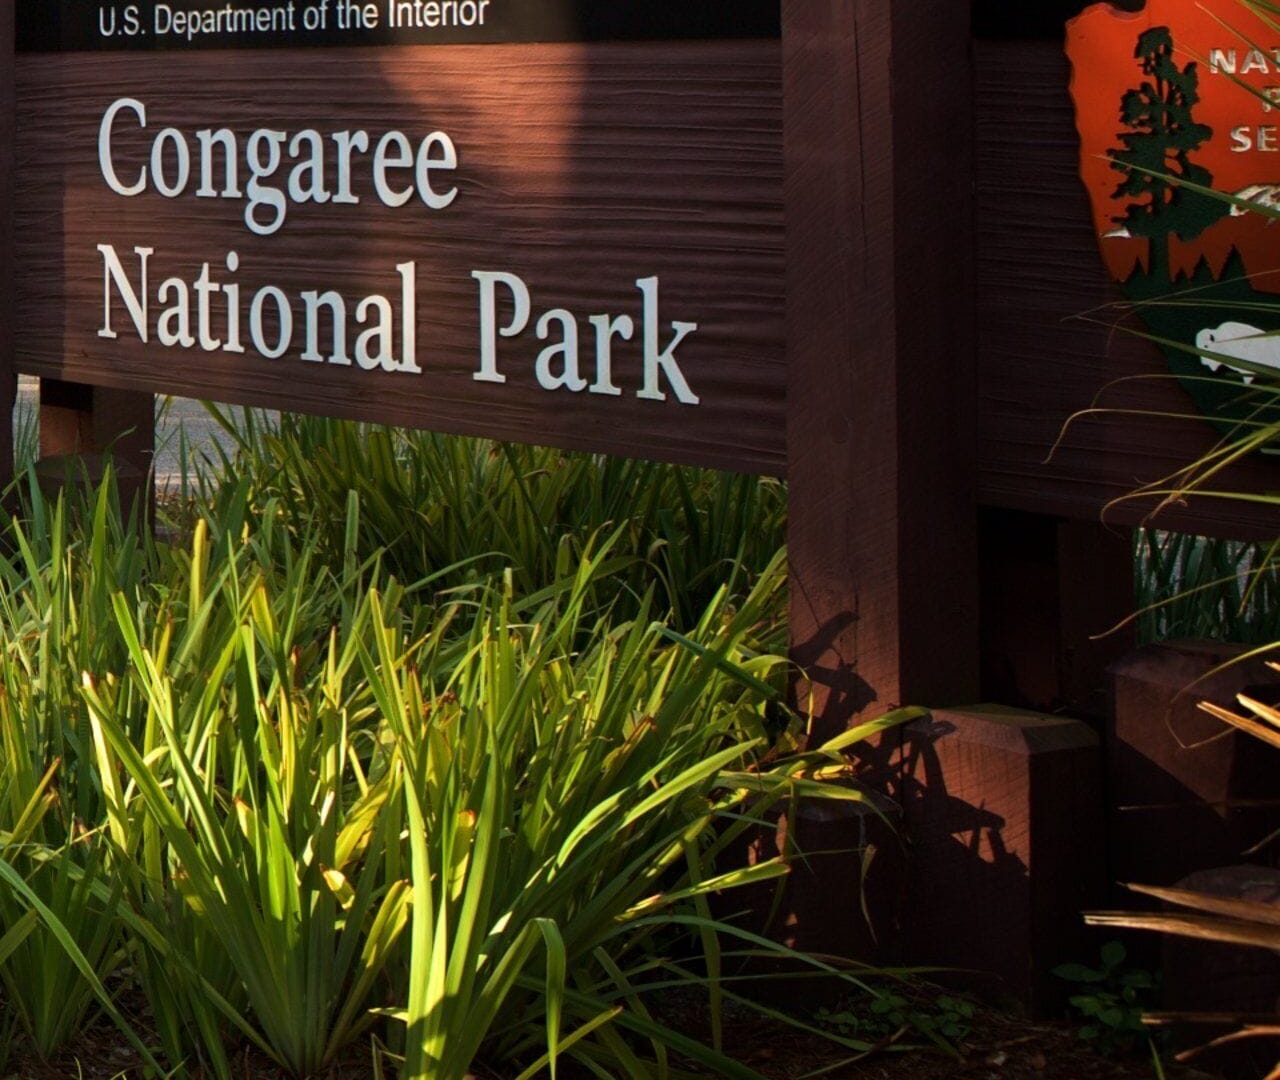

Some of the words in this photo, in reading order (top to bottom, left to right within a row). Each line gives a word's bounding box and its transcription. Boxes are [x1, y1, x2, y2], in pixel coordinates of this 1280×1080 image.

[99, 6, 146, 37] U.S.
[154, 1, 296, 41] Department
[98, 97, 458, 235] Congaree
[97, 243, 422, 374] National
[471, 269, 700, 405] Park
